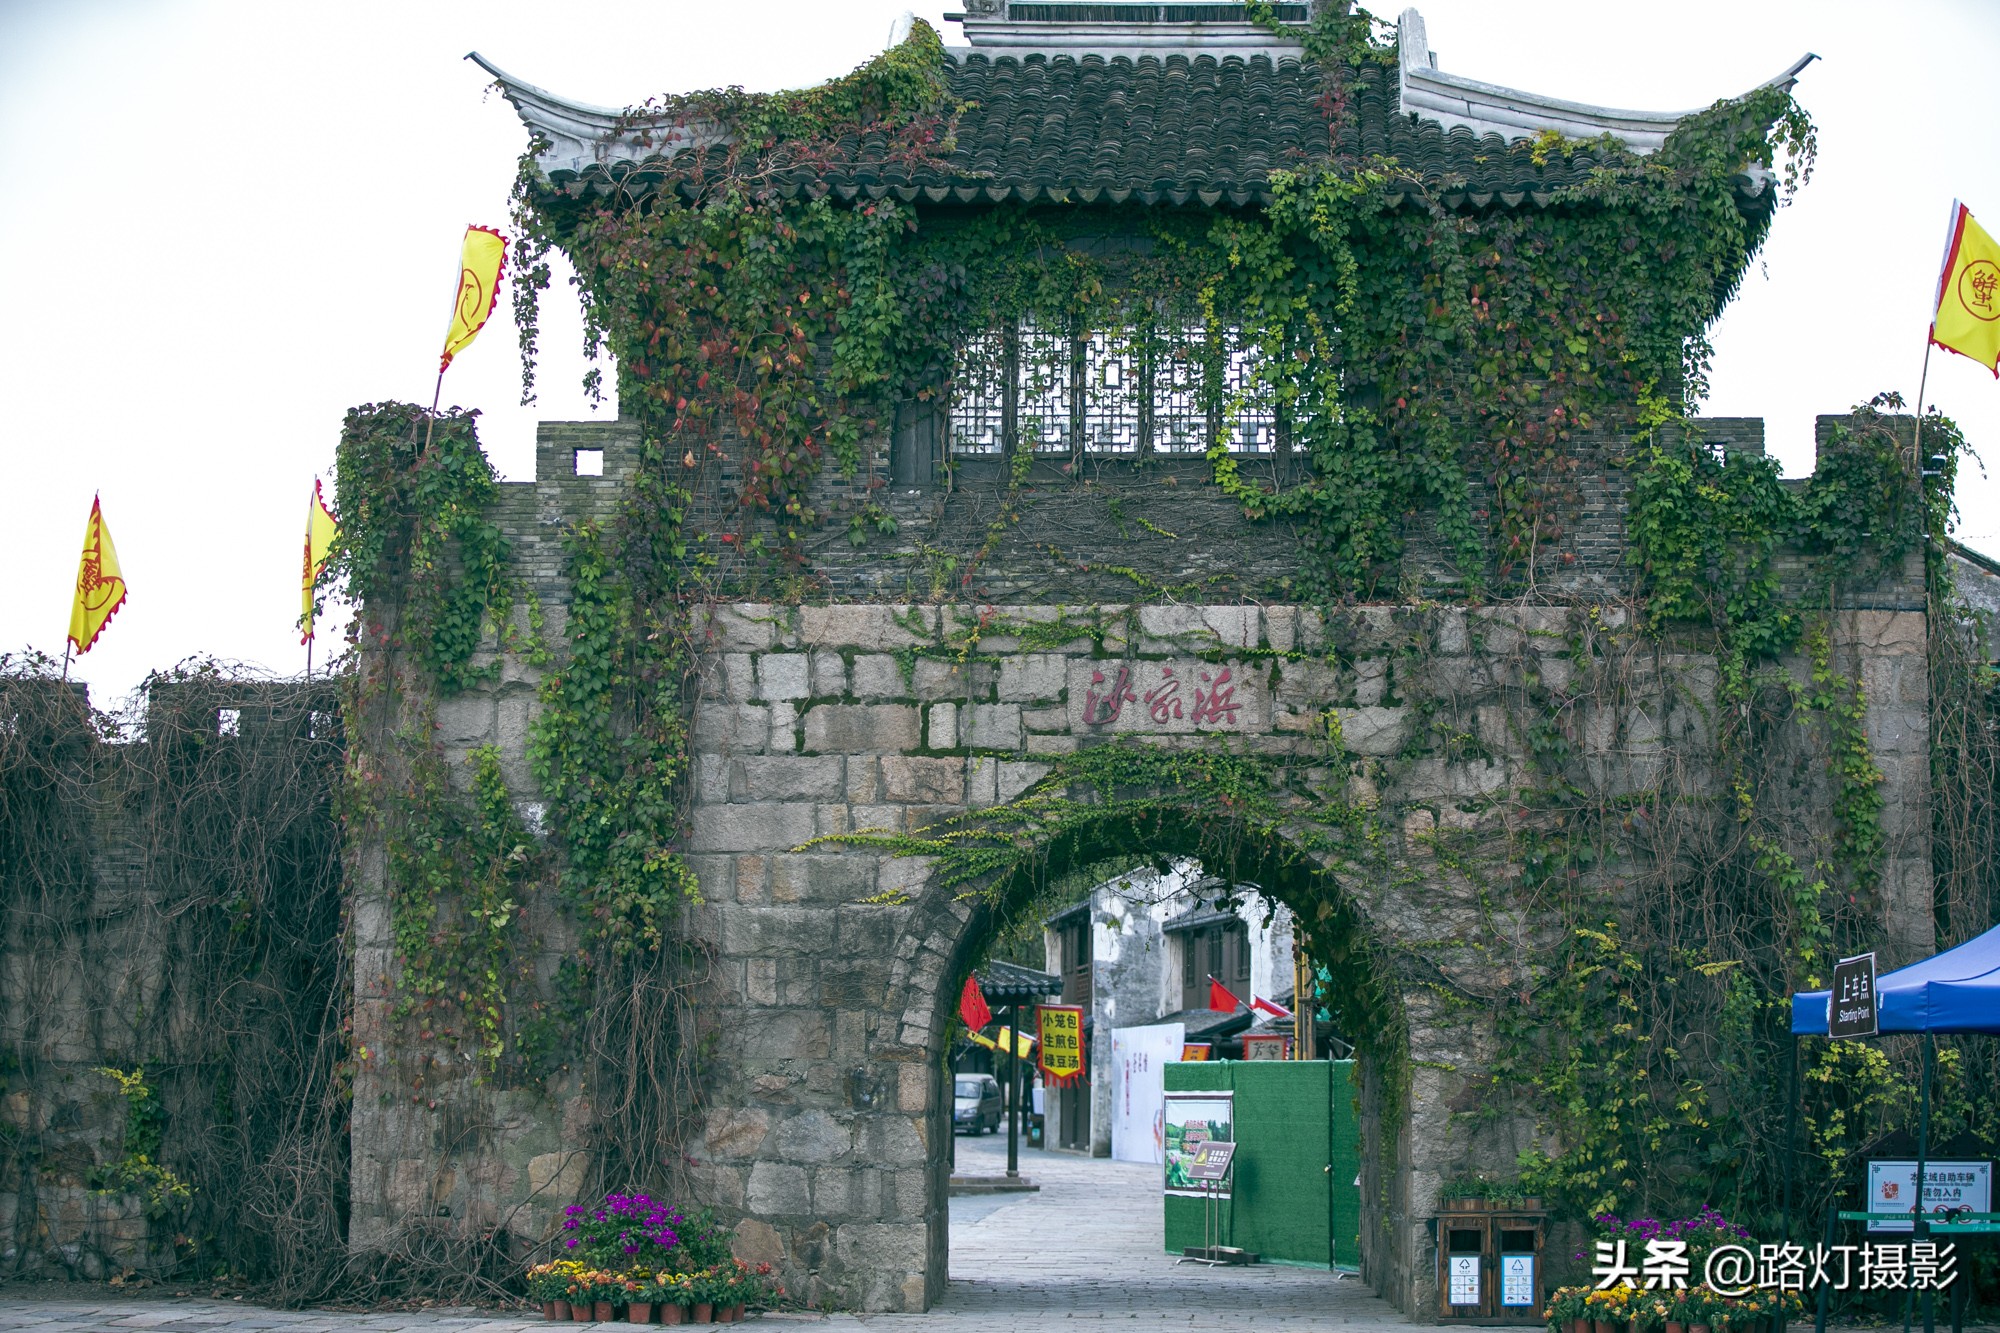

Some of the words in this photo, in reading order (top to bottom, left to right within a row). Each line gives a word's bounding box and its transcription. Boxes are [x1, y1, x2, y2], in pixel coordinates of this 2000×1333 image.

[1082, 667, 1243, 724] 沙家浜
[1839, 971, 1870, 1003] 上车点
[1043, 1012, 1078, 1029] 小笼包
[1839, 1008, 1858, 1024] Starting
[1857, 1005, 1870, 1020] Point
[1043, 1033, 1078, 1049] 生煎包
[1044, 1053, 1079, 1069] 绿豆汤
[1923, 1188, 1961, 1198] 请勿入内
